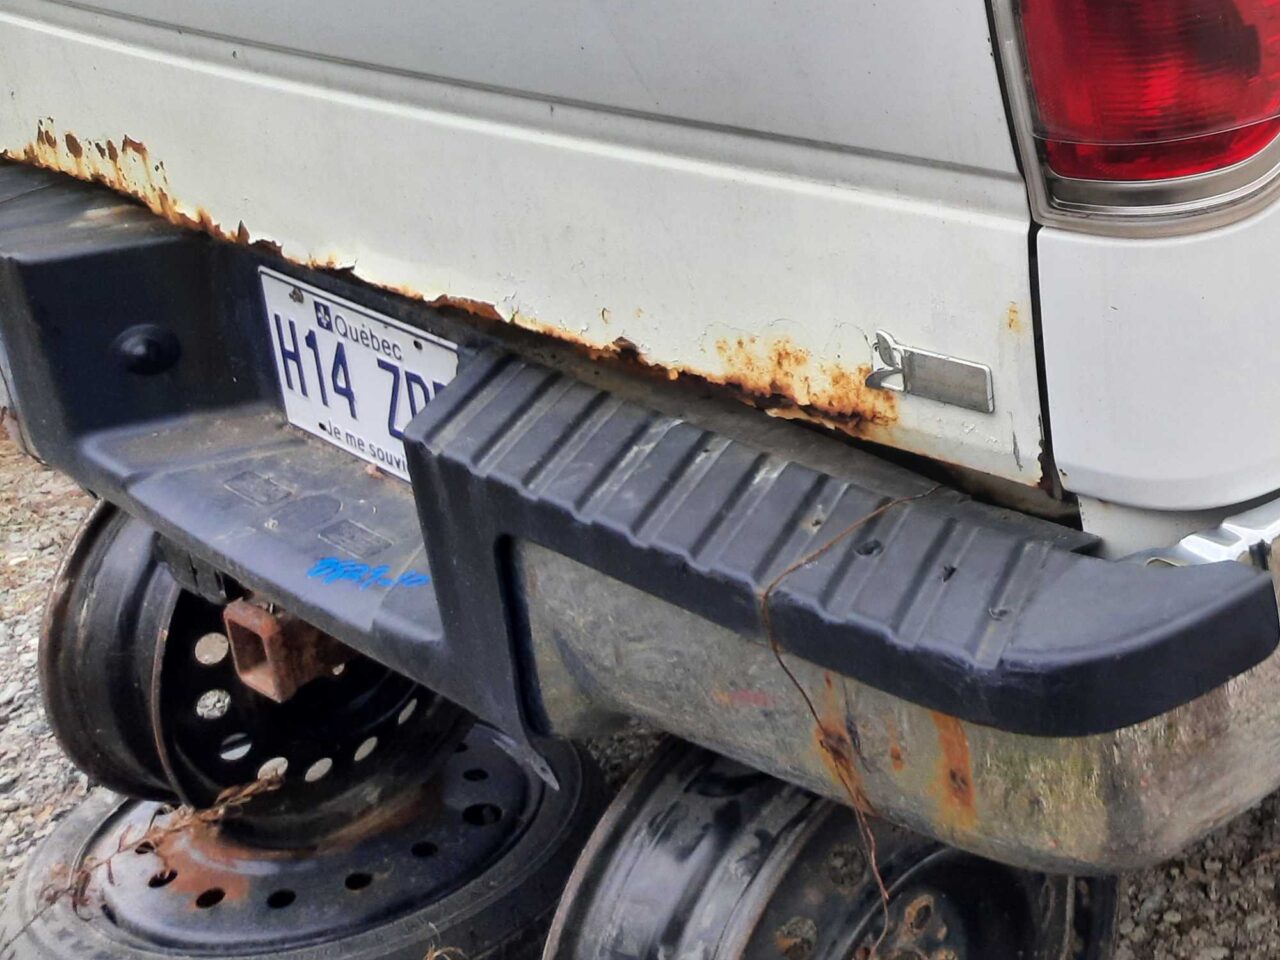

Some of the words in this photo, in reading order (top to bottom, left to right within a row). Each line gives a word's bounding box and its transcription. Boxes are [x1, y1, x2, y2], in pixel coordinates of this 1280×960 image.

[333, 313, 404, 362] Québec
[273, 312, 359, 421] H14
[376, 356, 446, 441] ZD
[326, 420, 342, 441] Je
[345, 432, 366, 453] me
[368, 444, 409, 473] souvi
